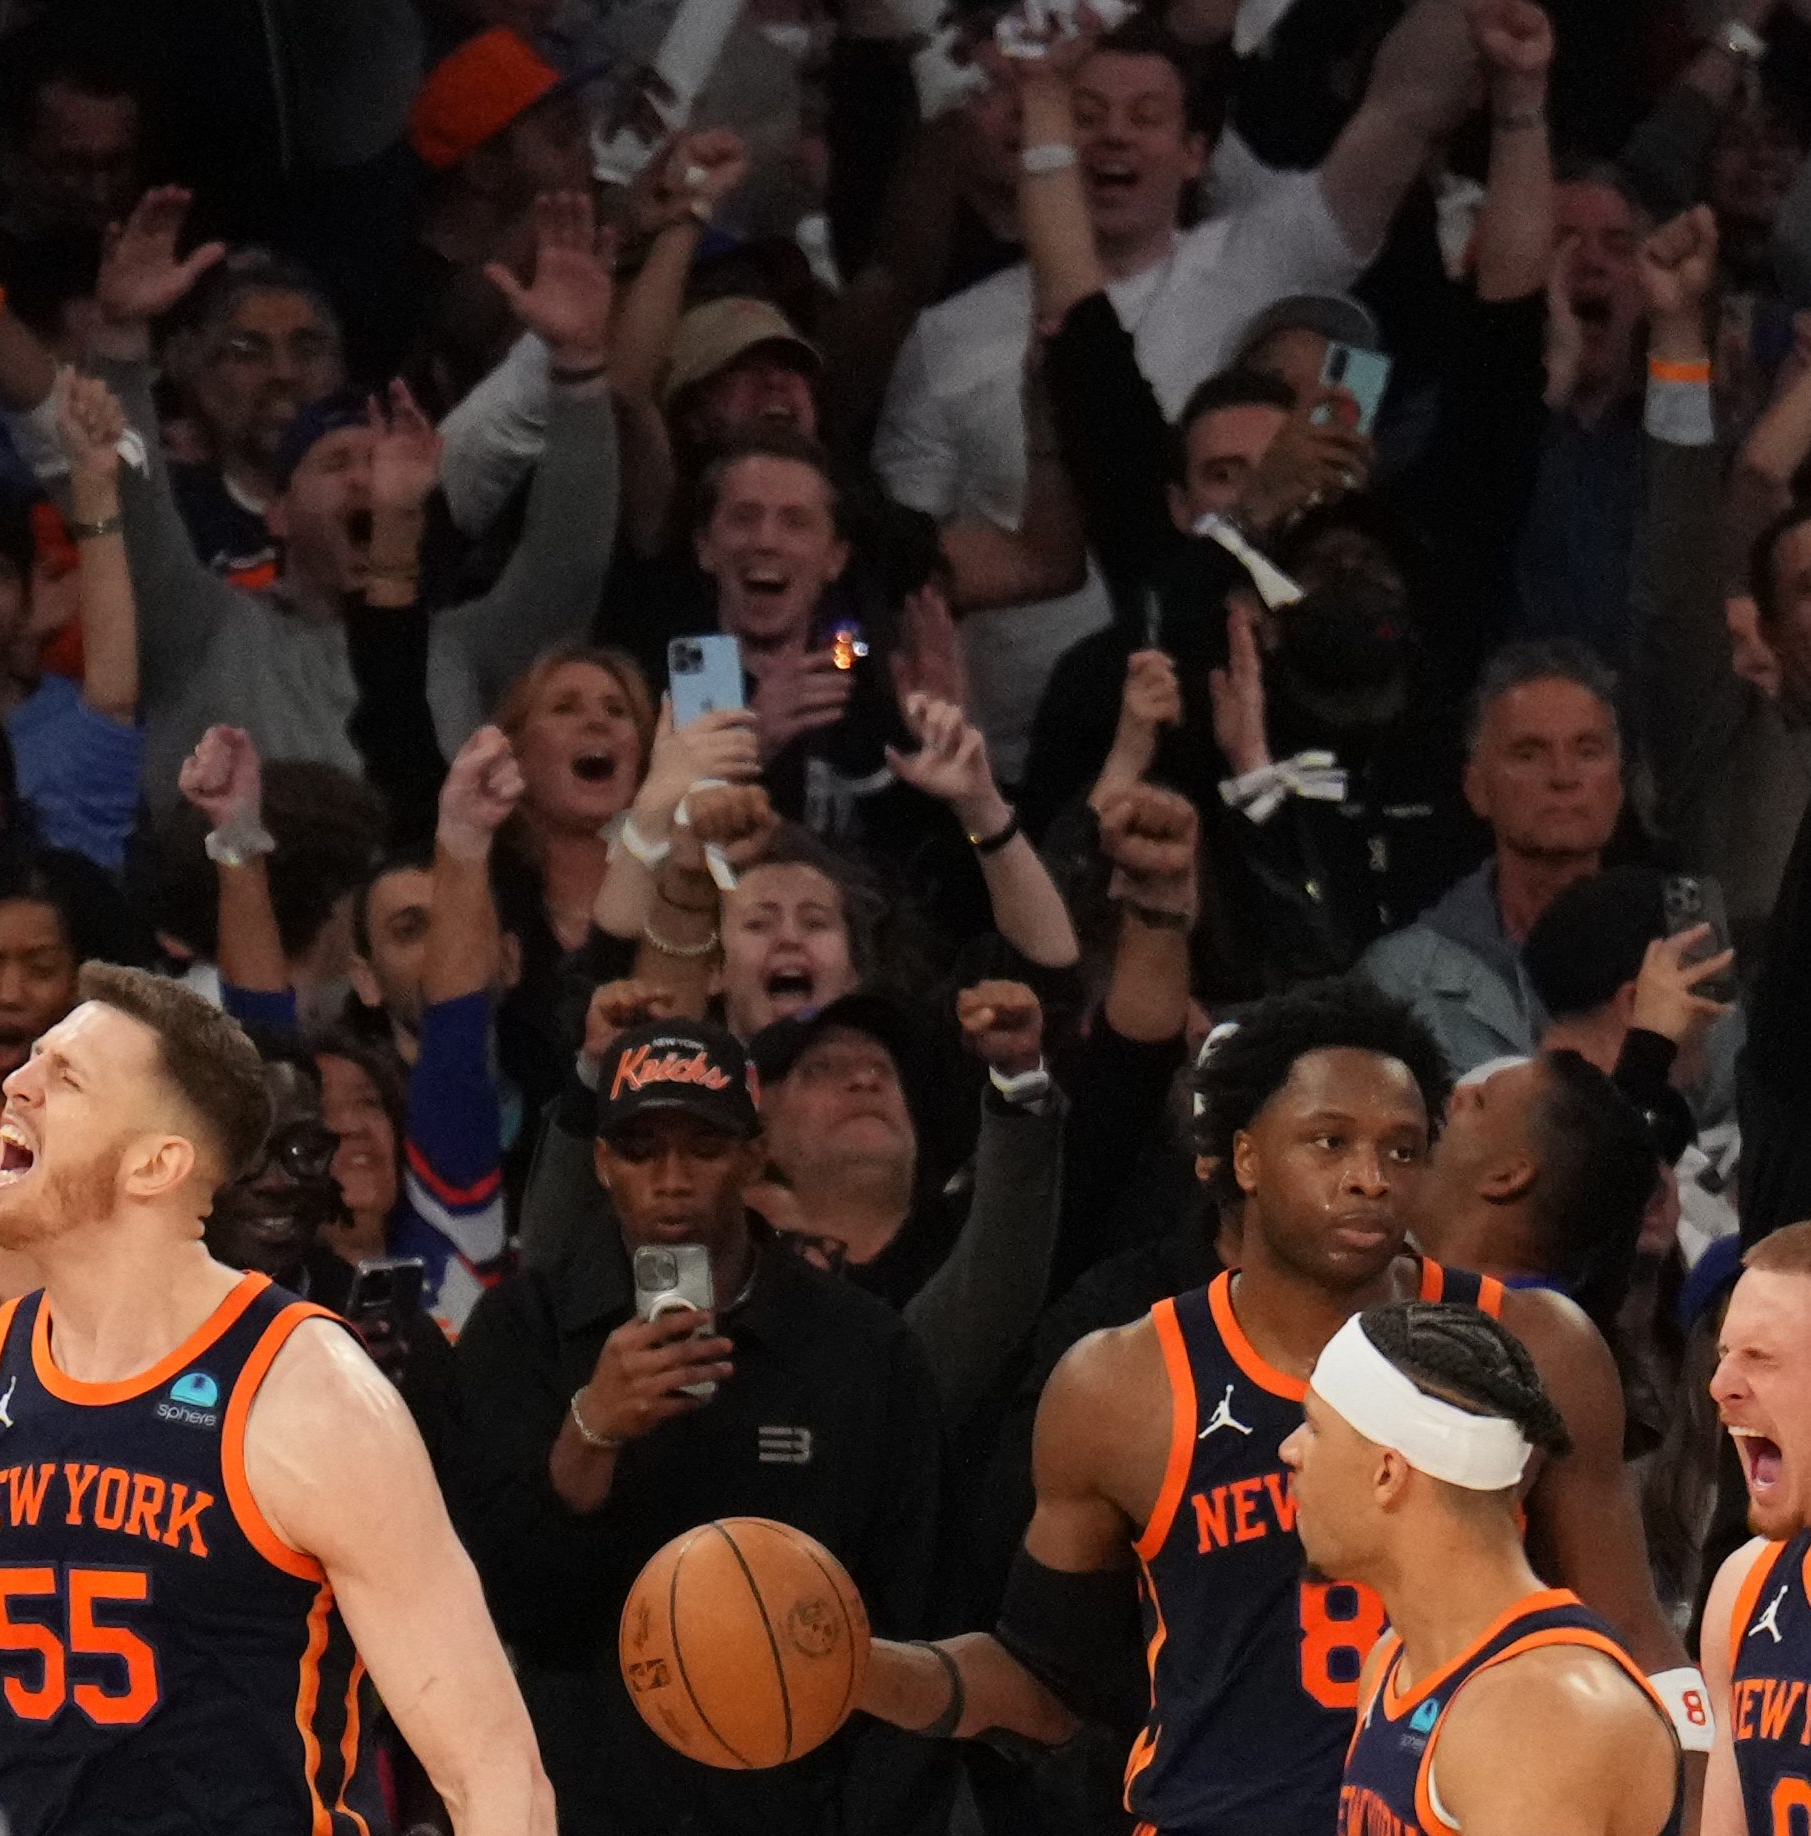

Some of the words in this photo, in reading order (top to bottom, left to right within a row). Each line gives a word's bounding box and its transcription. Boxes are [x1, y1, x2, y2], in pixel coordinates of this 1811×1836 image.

[610, 1044, 732, 1101] Knicks
[157, 1403, 217, 1427] sphere
[64, 1463, 215, 1559] YORK
[1299, 1577, 1385, 1710] 8
[1683, 1689, 1706, 1726] 8
